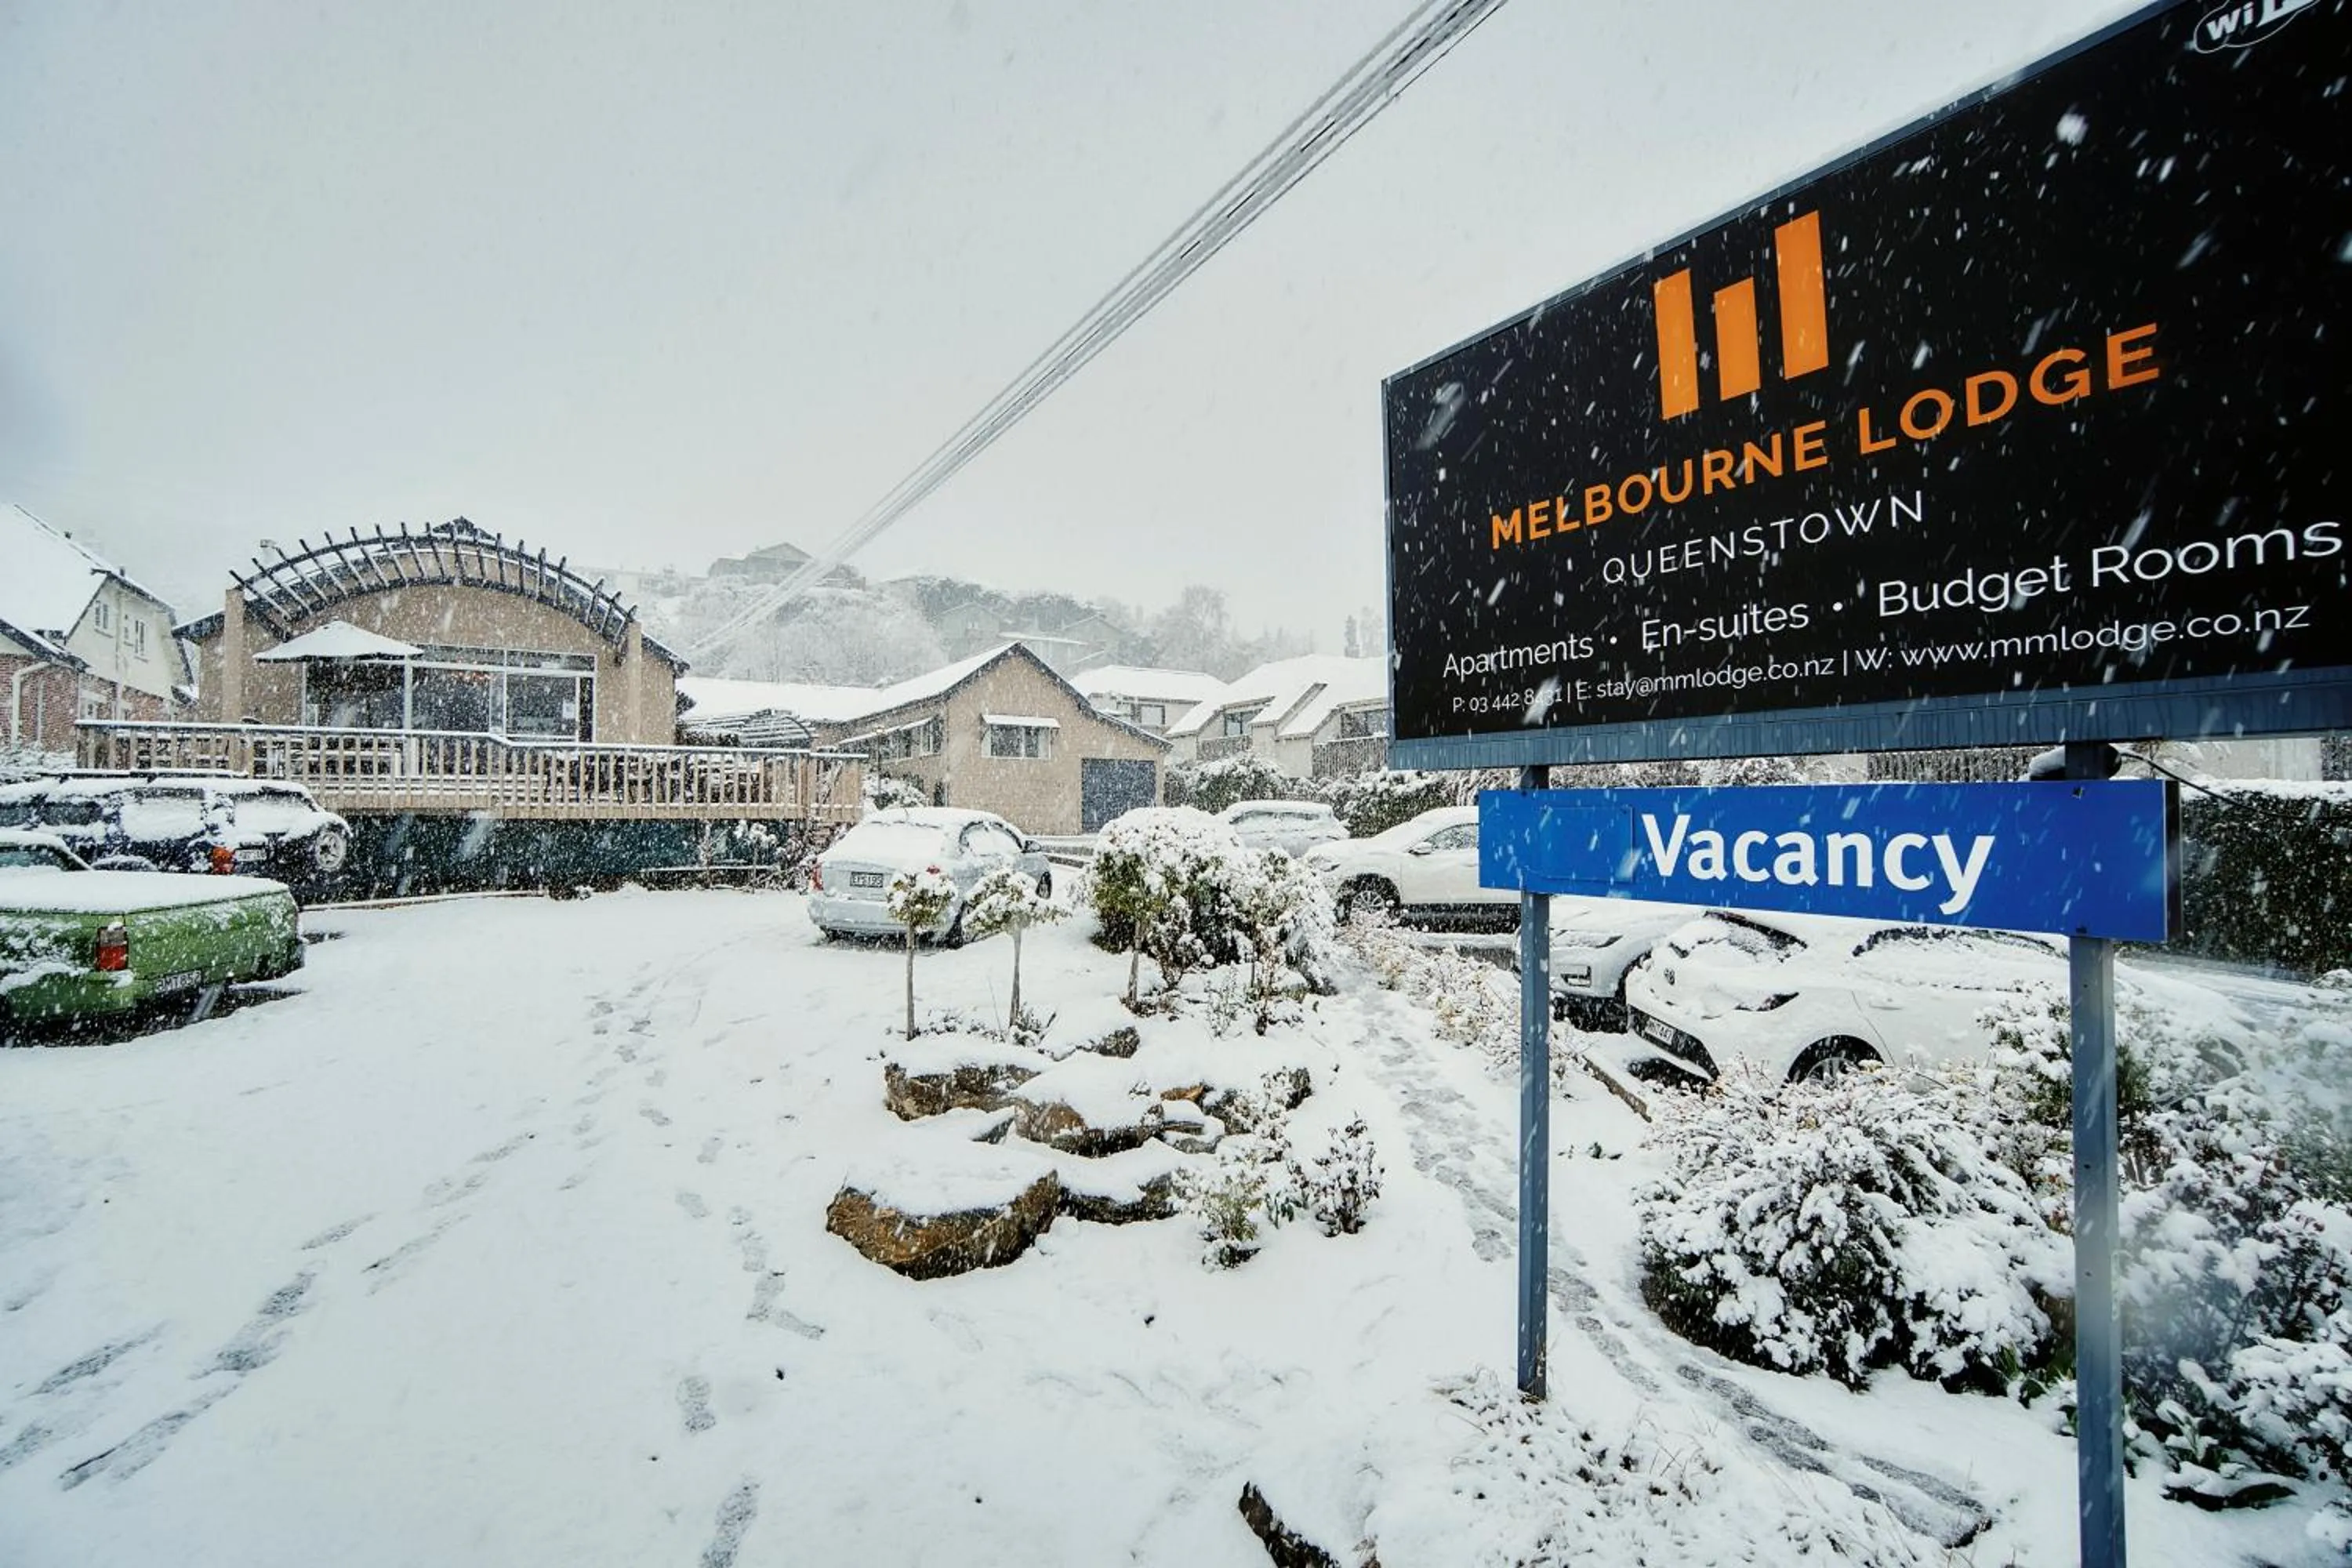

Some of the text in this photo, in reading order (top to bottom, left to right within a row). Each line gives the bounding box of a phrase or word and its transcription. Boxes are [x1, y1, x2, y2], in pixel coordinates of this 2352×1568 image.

[1492, 322, 2160, 550] MELBOURNE LODGE
[1602, 491, 1925, 585] QUEENSTOWN
[1443, 521, 2344, 683] Apartments En-suites Budget Rooms
[1468, 696, 1489, 713] 03
[1492, 692, 1520, 711] 442
[1596, 657, 1835, 701] stay@mmlodge.co.nz
[1900, 604, 2311, 666] www.mmlodge.co.nz
[1641, 813, 1995, 915] Vacancy
